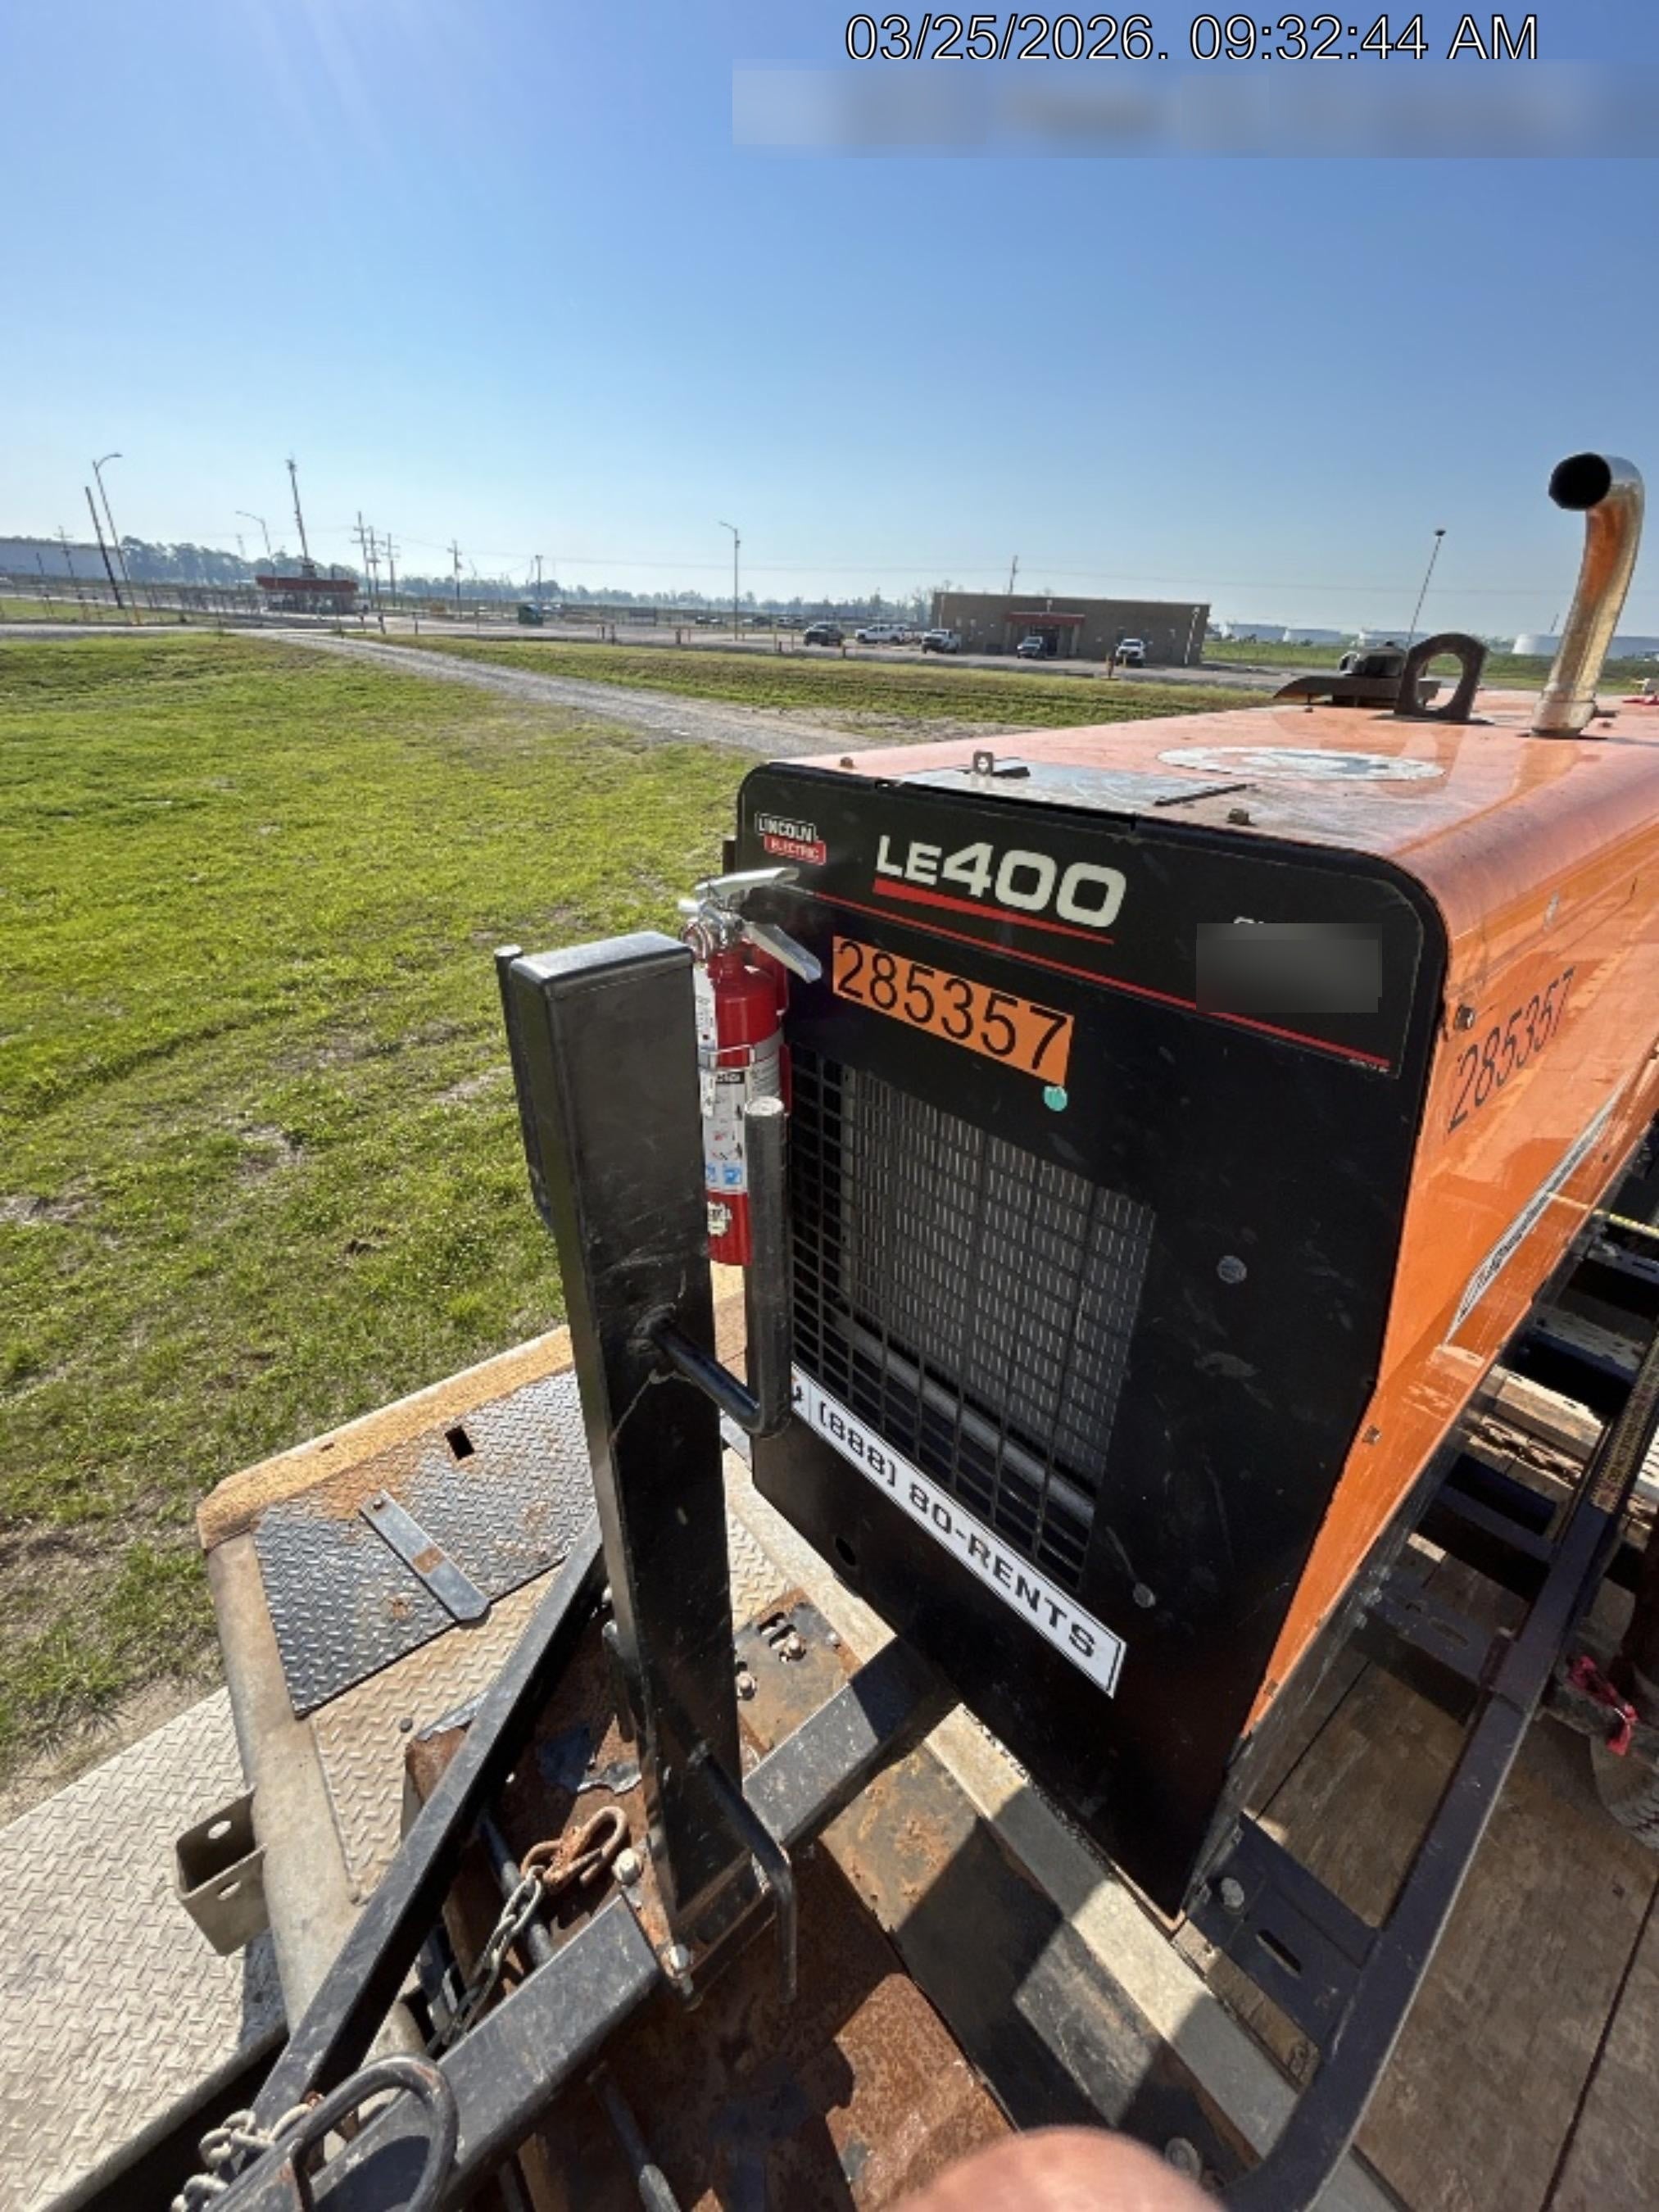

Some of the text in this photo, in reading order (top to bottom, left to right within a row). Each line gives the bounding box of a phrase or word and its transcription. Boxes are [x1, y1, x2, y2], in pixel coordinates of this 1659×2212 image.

[759, 818, 813, 842] LINCOLN
[877, 835, 1126, 927] LE400
[836, 941, 1067, 1071] 285357
[1448, 967, 1576, 1134] 285357
[909, 1484, 1096, 1657] 80-RENTS
